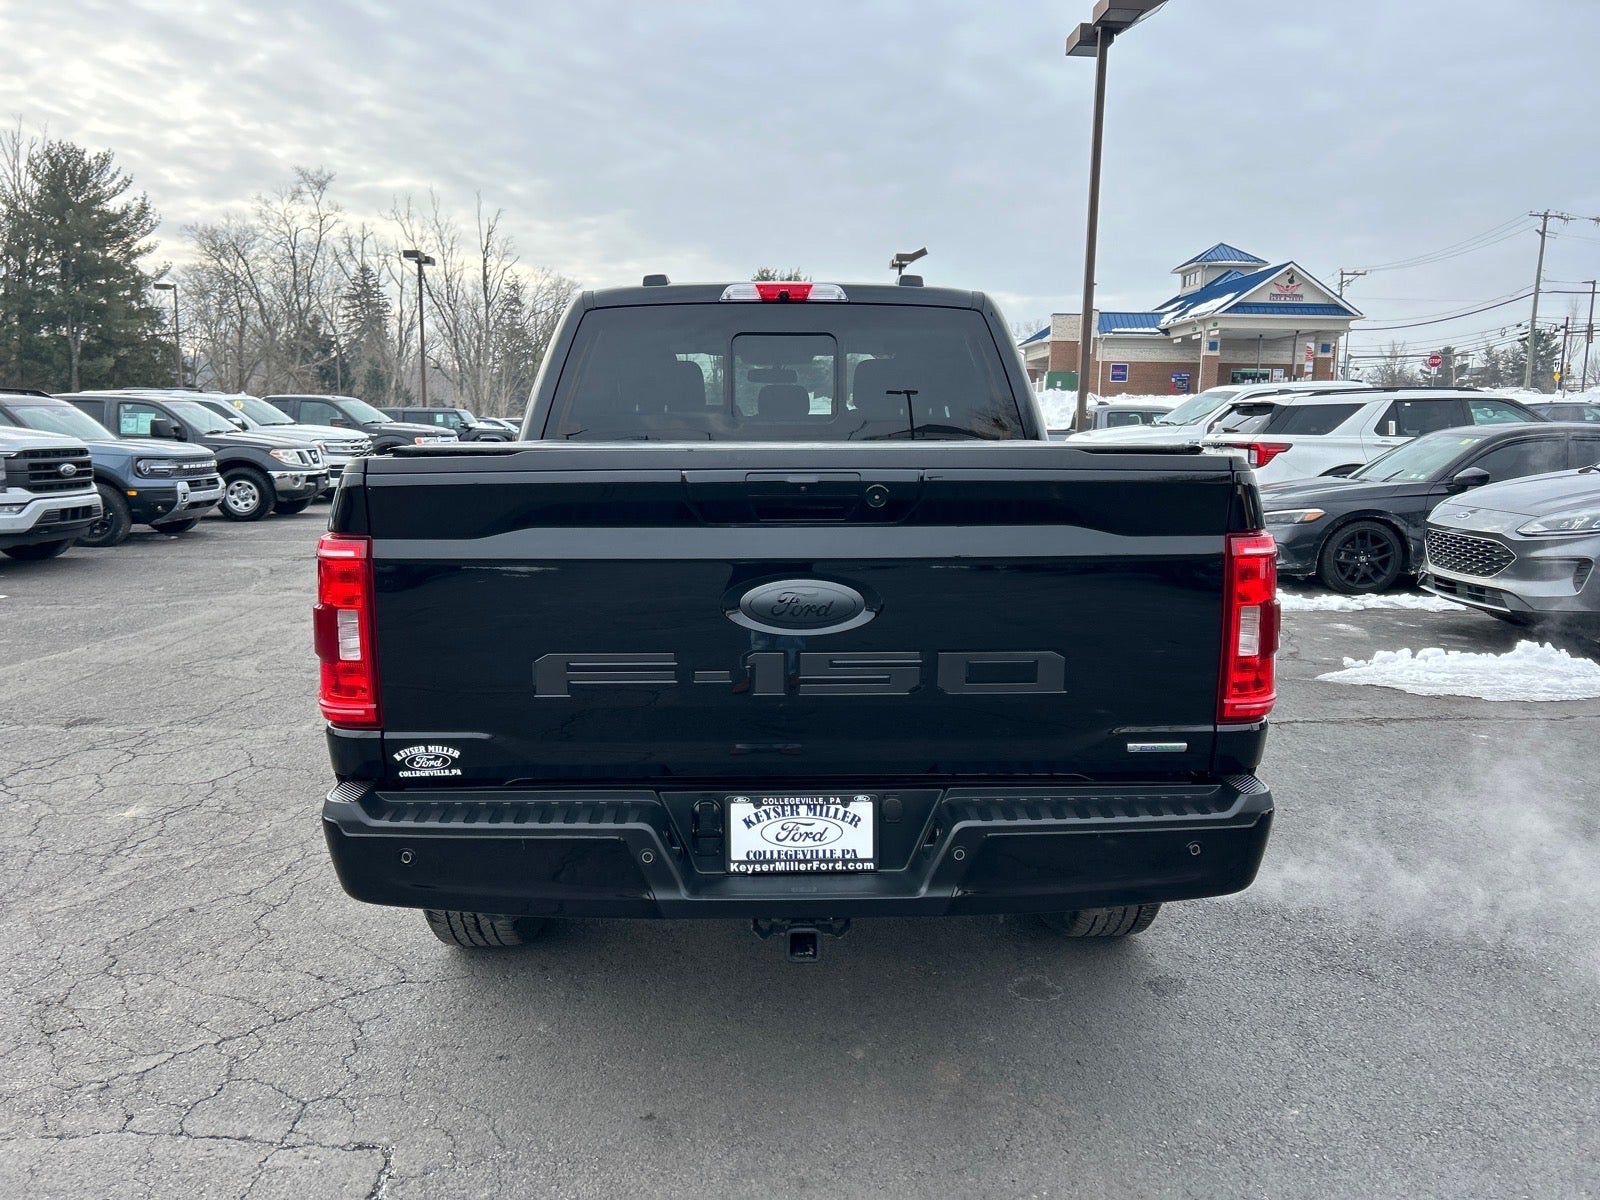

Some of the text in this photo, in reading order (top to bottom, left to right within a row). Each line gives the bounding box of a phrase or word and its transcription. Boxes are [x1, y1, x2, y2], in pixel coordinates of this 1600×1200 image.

[770, 592, 833, 617] Ford
[533, 651, 1067, 697] F-150
[393, 745, 461, 762] KEYSER MILLER
[413, 755, 443, 768] Ford
[829, 797, 842, 805] PA
[742, 804, 862, 831] KEYSER MILLER
[775, 821, 829, 843] Ford
[730, 861, 875, 874] KeyserMillerFord.com
